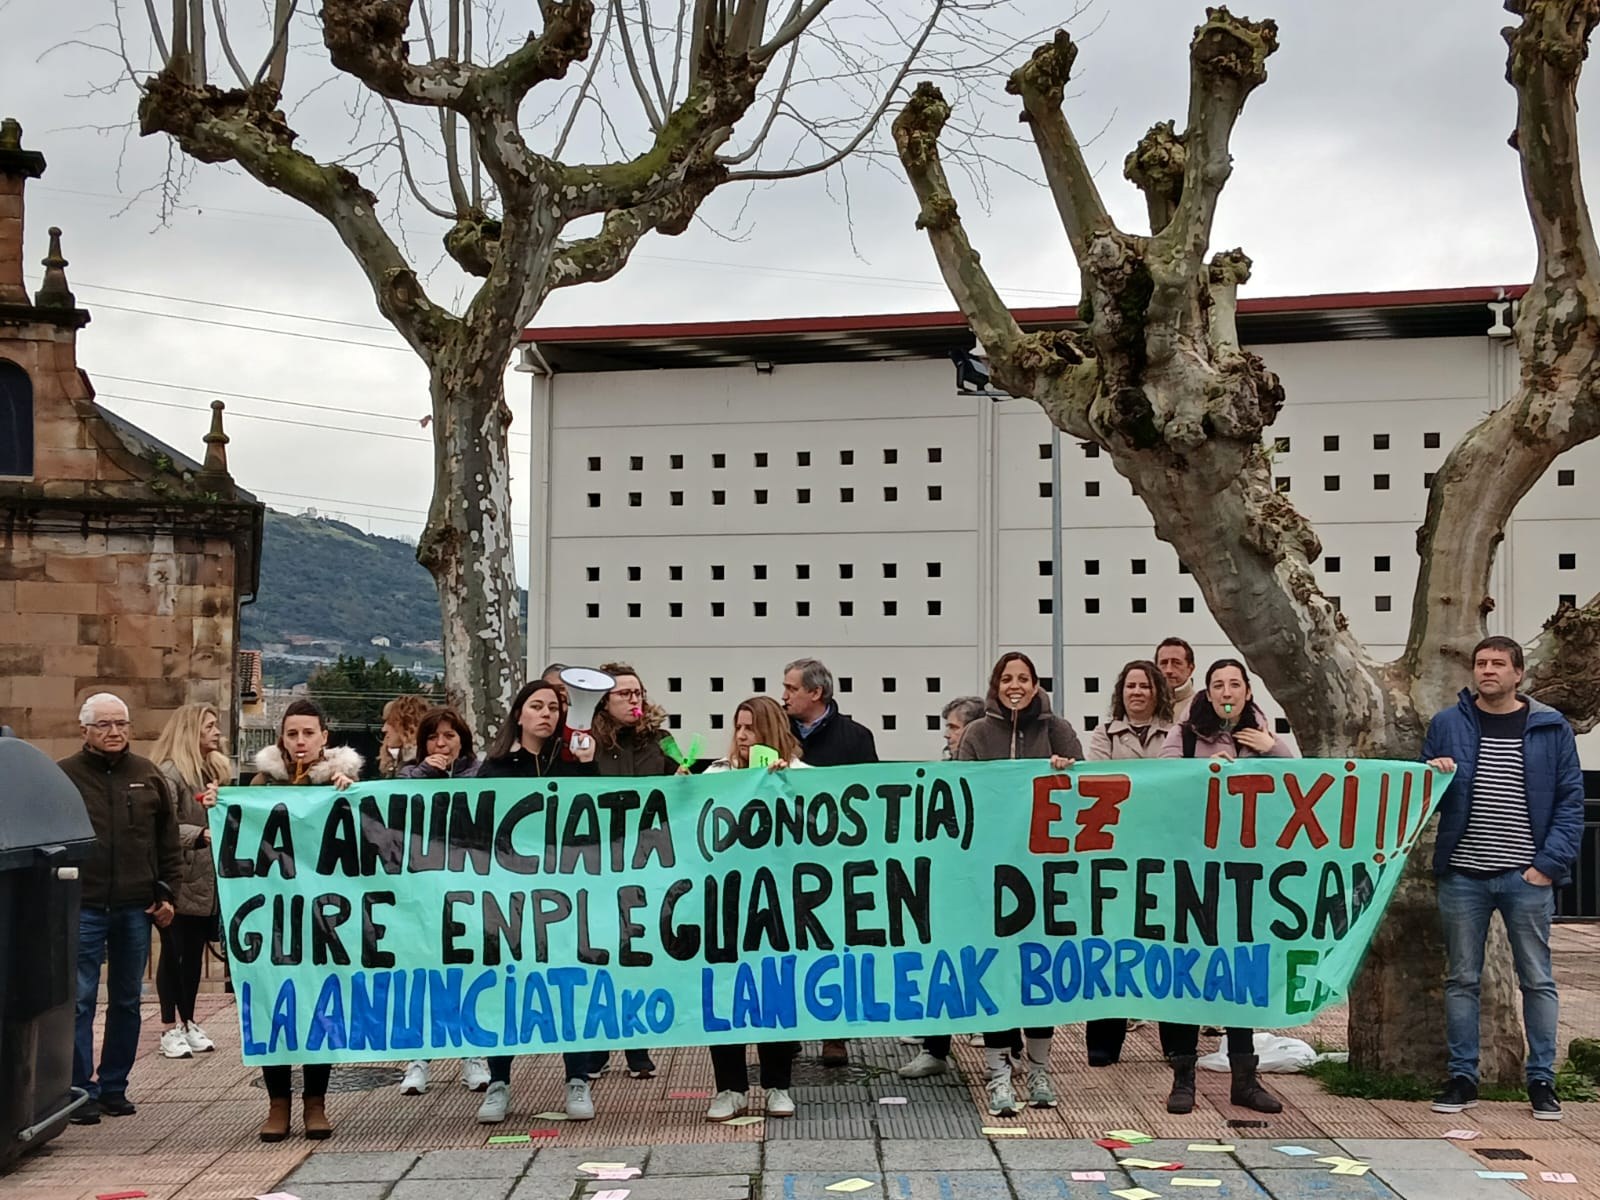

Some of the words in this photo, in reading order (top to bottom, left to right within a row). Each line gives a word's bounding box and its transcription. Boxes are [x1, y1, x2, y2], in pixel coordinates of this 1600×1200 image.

[219, 803, 296, 879] LA
[1028, 773, 1131, 854] EZ
[229, 890, 396, 968] GURE
[442, 856, 932, 967] ENPLEGUAREN
[241, 978, 298, 1055] LA
[1020, 937, 1271, 1008] BORROKAN
